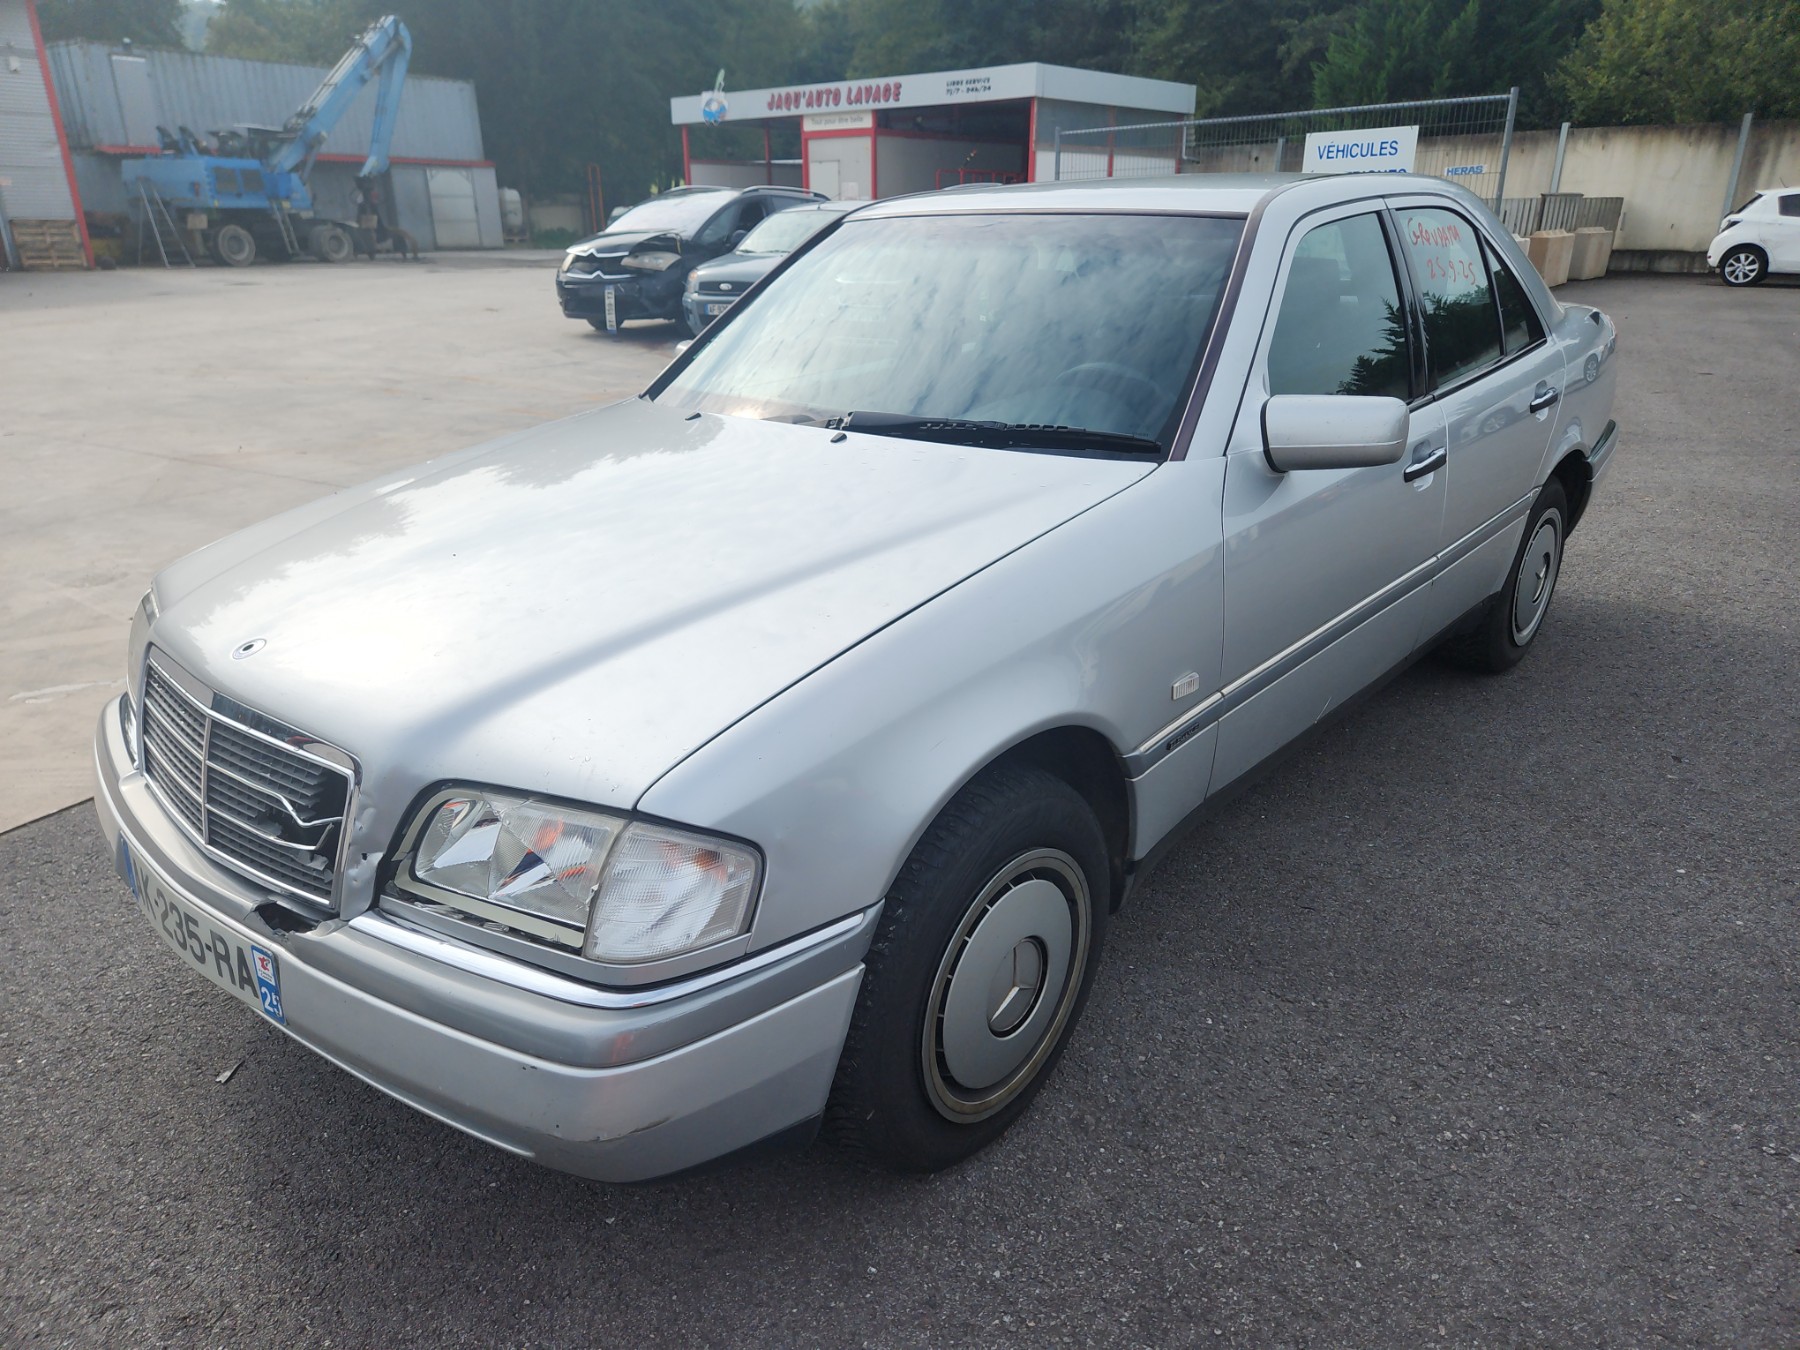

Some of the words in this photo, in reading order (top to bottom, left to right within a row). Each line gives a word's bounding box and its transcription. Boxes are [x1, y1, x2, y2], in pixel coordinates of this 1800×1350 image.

[767, 87, 842, 111] JAQU'AUTO
[846, 82, 902, 106] LAVAGE
[1446, 165, 1484, 176] HERAS
